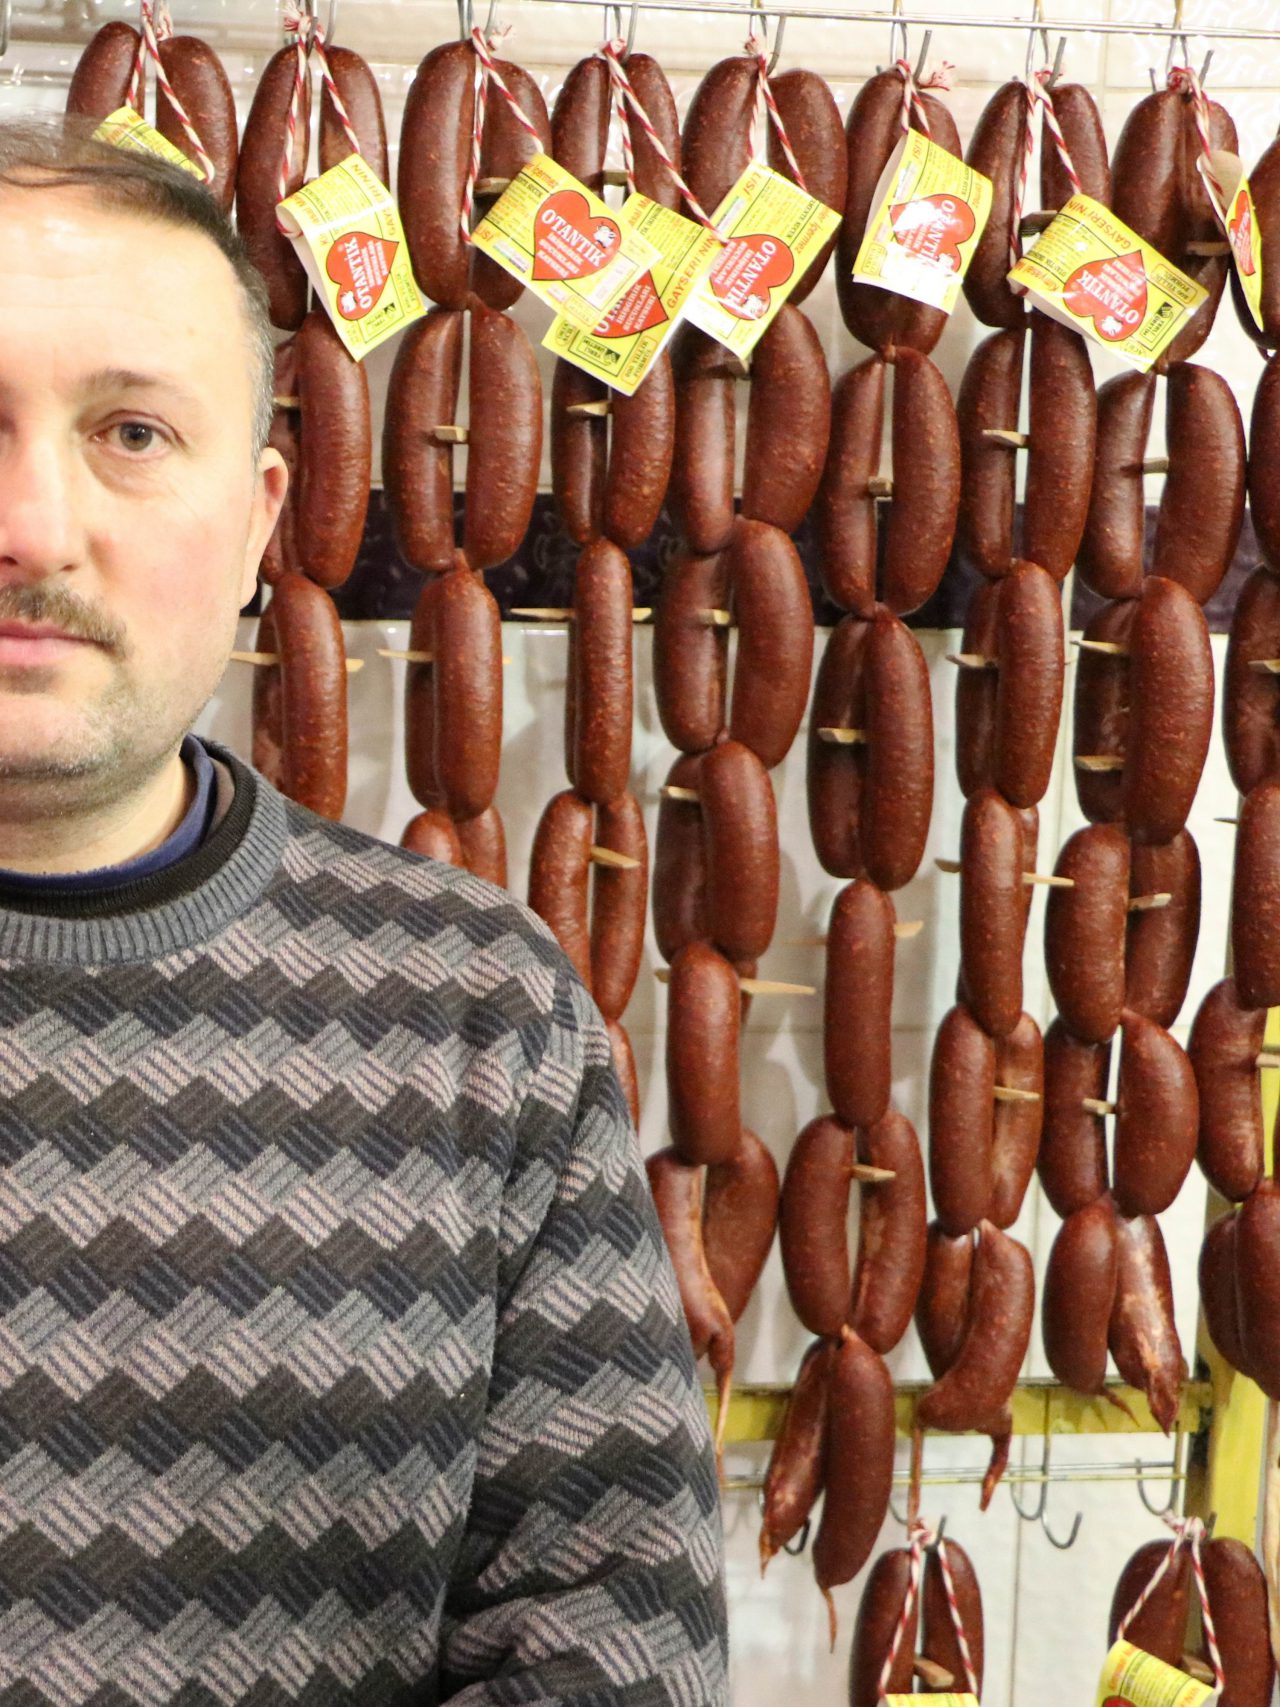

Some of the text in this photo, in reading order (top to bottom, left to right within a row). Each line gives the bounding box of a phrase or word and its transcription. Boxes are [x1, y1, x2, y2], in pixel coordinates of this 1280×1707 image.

[540, 208, 606, 267] OTANTİK
[344, 237, 372, 309] OTANTİK
[726, 240, 777, 305] OTANTİK
[1075, 270, 1139, 325] OTANTİK
[623, 285, 651, 331] SUCUKLARI
